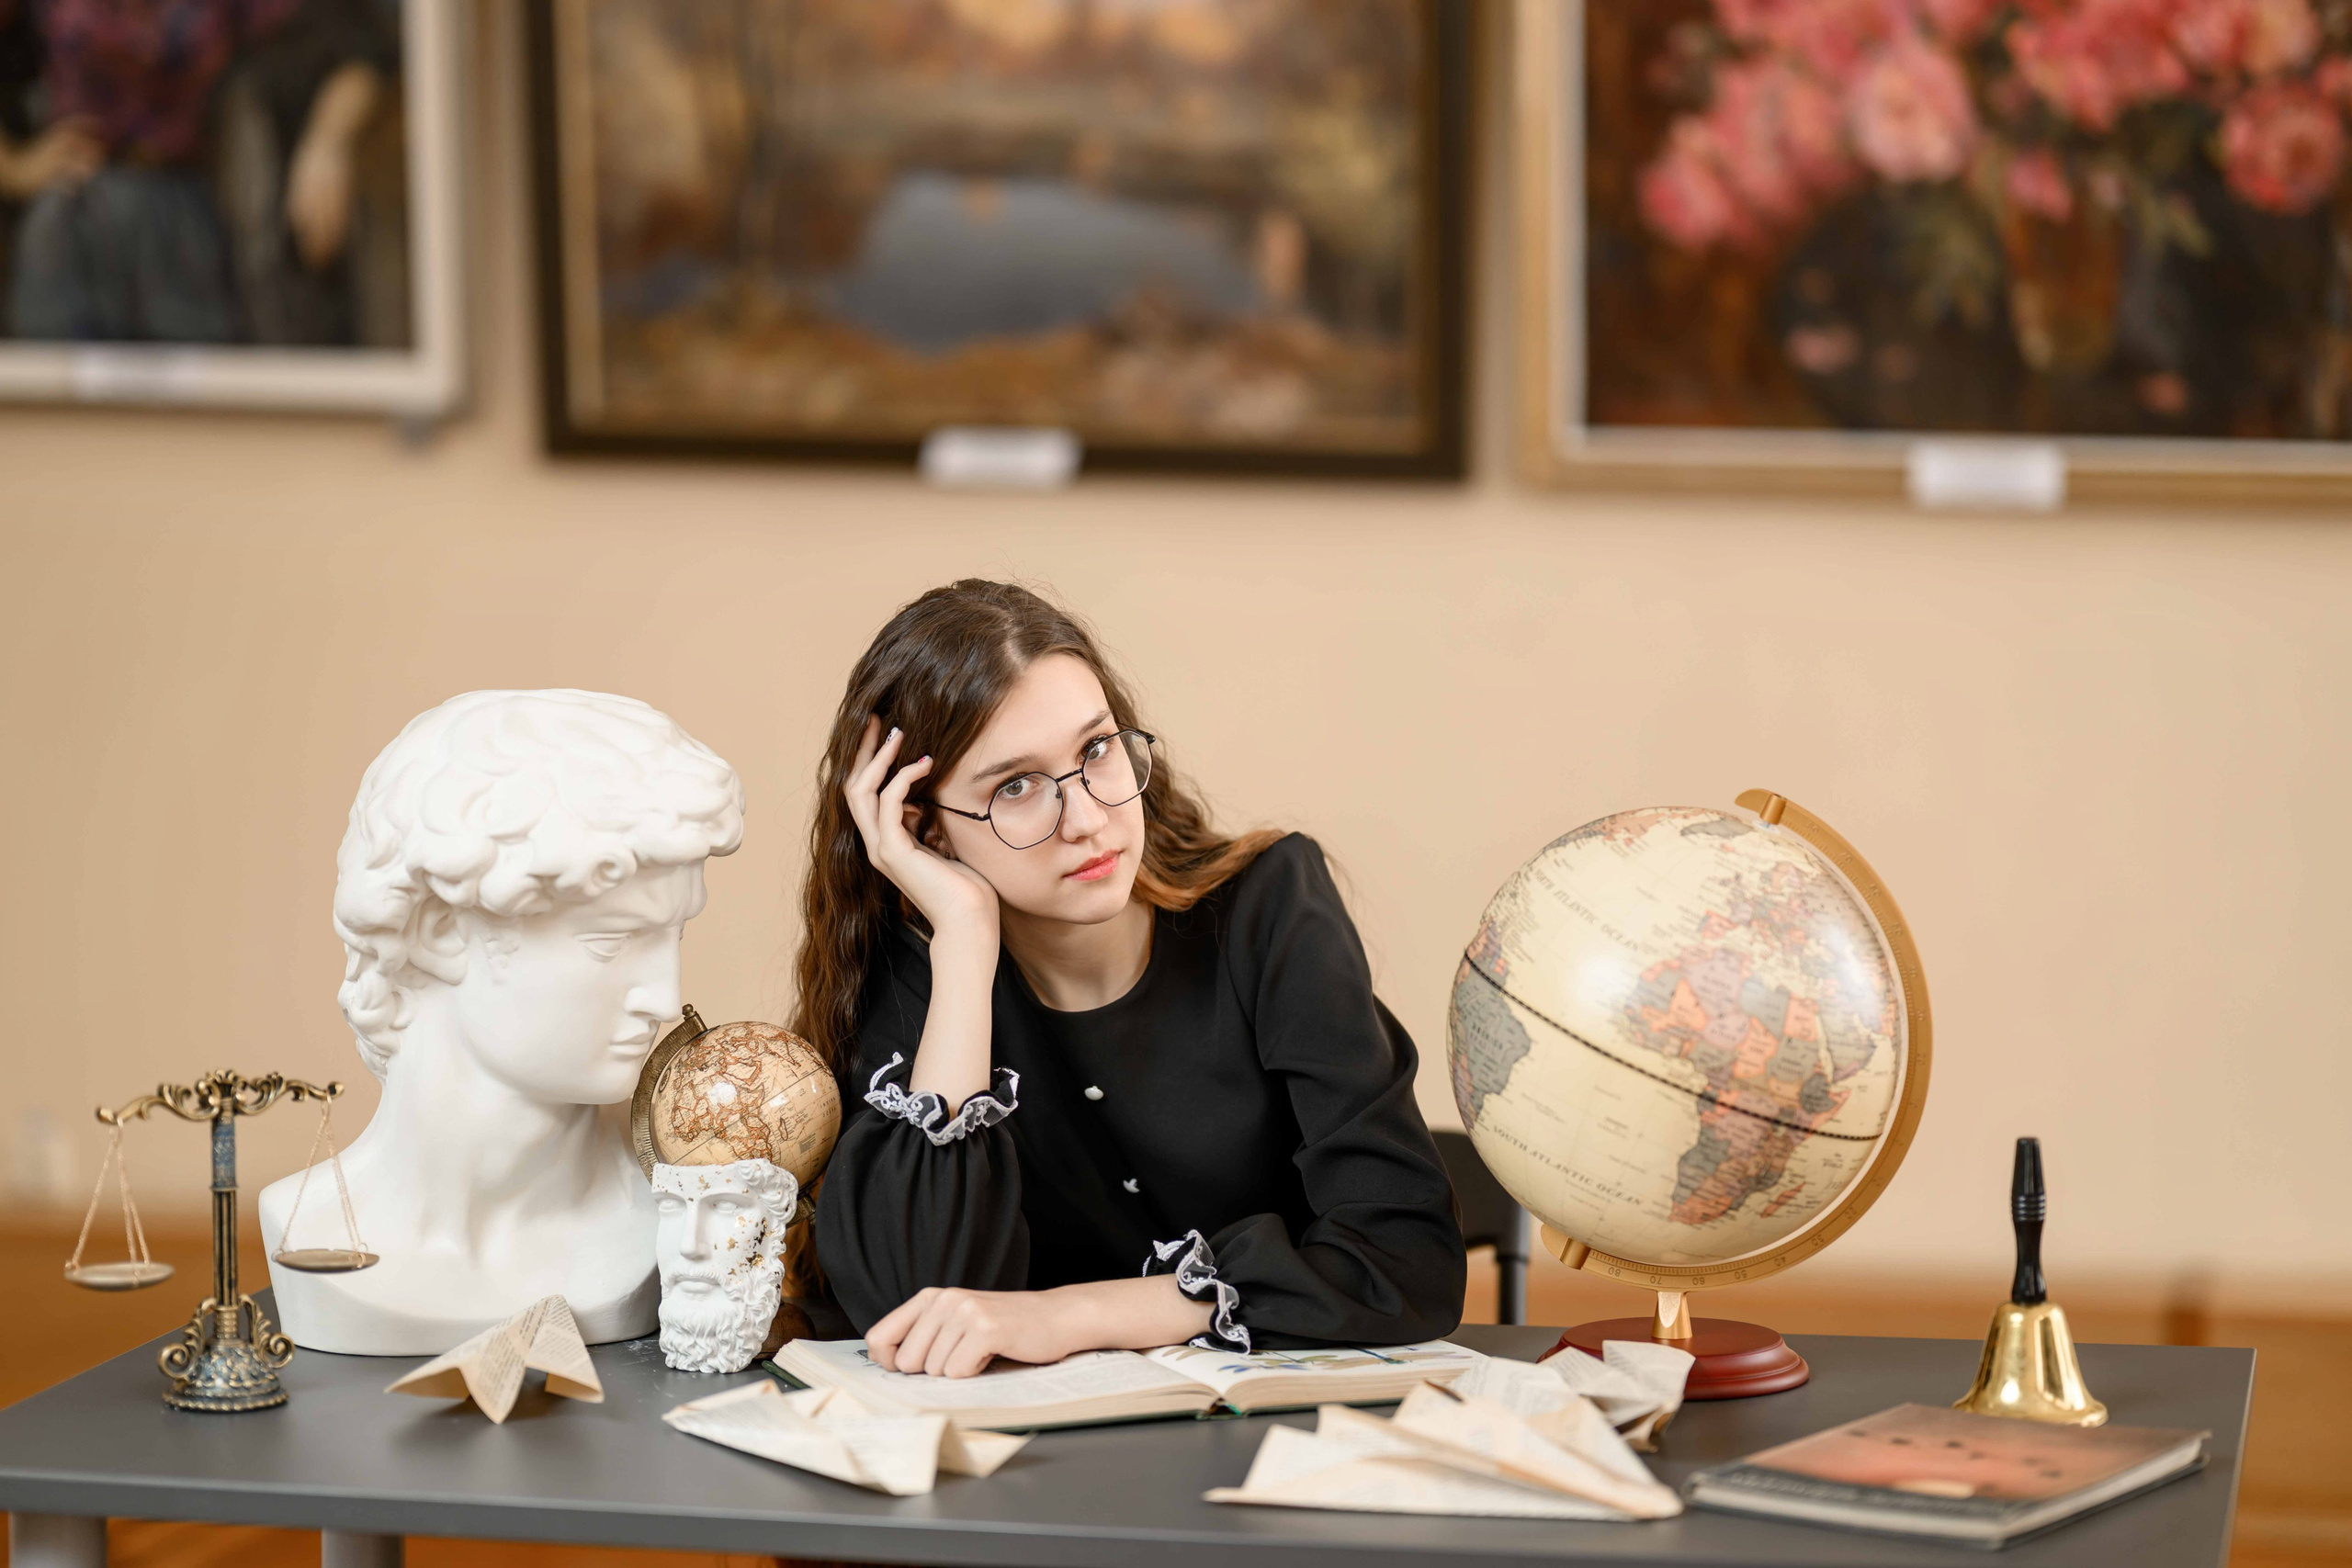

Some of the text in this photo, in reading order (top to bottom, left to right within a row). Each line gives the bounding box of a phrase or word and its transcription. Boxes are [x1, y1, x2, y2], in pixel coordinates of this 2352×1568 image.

[1553, 889, 1600, 925] ATLANTIC
[1600, 923, 1639, 951] OCEAN
[1493, 1125, 1528, 1152] SOUTH
[1529, 1150, 1594, 1186] ATLANTIC
[1597, 1181, 1643, 1207] OCEAN
[1773, 1256, 1787, 1268] 40
[1607, 1266, 1622, 1278] 80
[1734, 1269, 1748, 1280] 50
[1649, 1275, 1663, 1286] 70
[1691, 1276, 1706, 1286] 60
